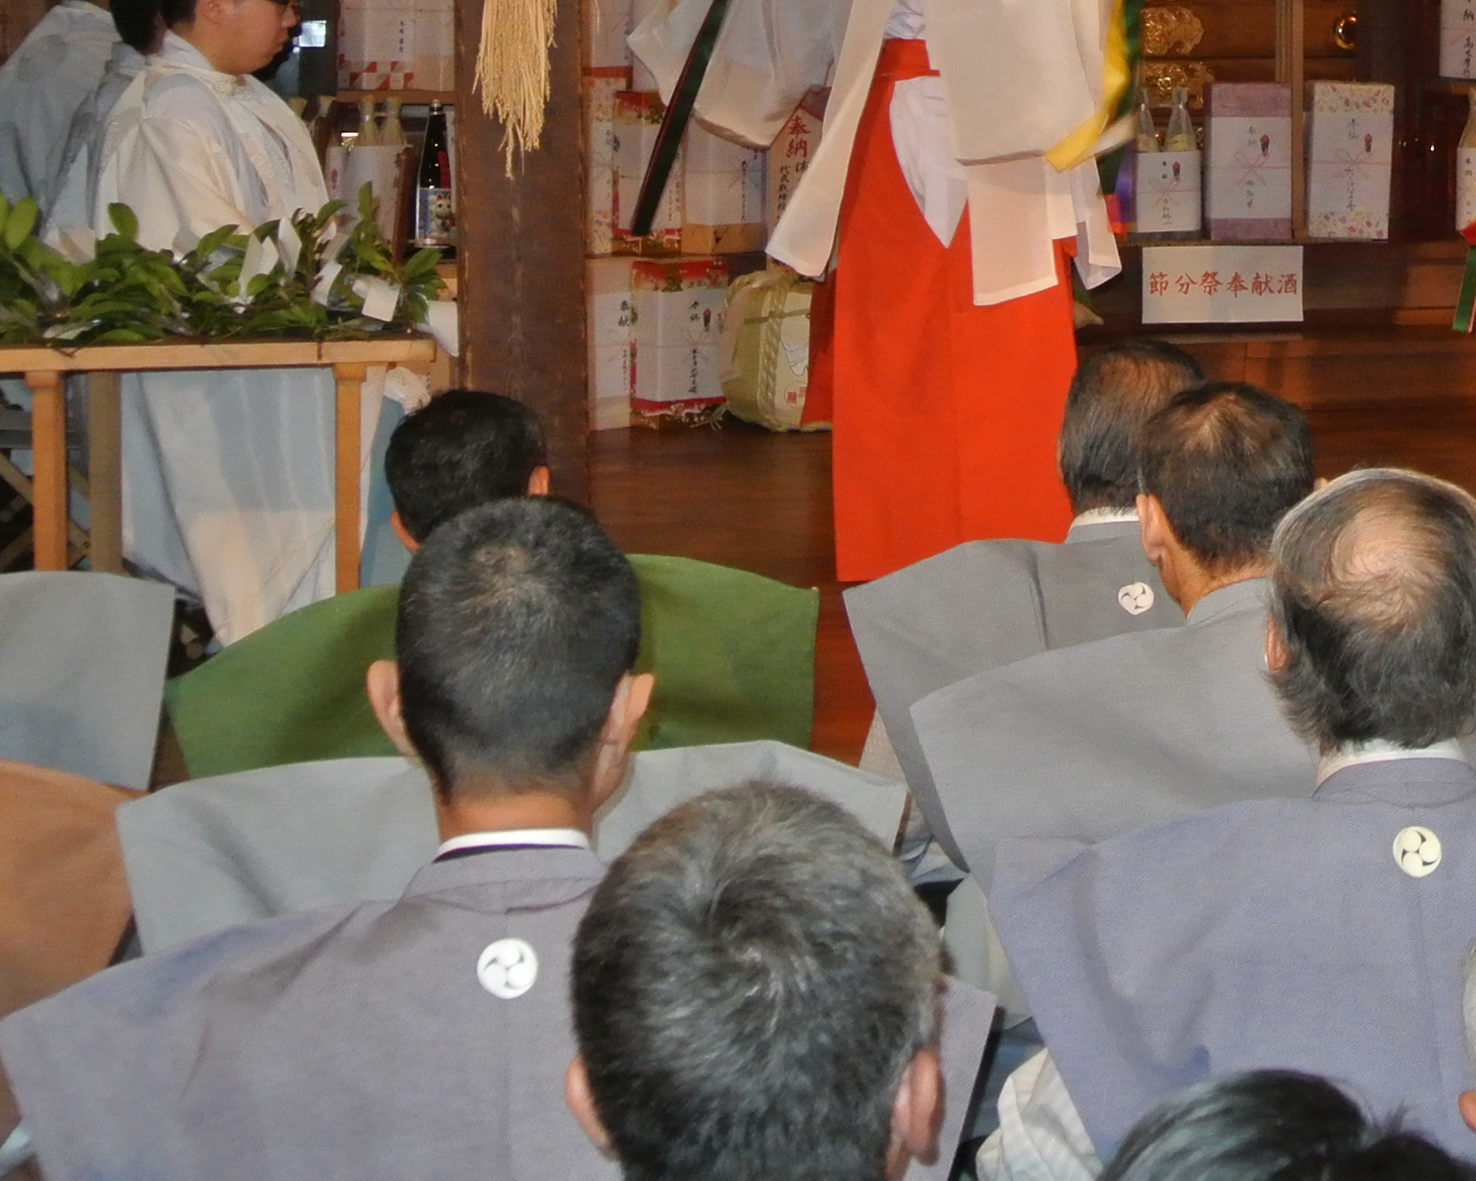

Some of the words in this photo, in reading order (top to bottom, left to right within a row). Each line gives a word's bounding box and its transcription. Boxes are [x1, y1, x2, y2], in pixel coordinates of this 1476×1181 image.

[785, 115, 812, 159] 奉納
[1149, 270, 1298, 298] 節分祭奉献酒
